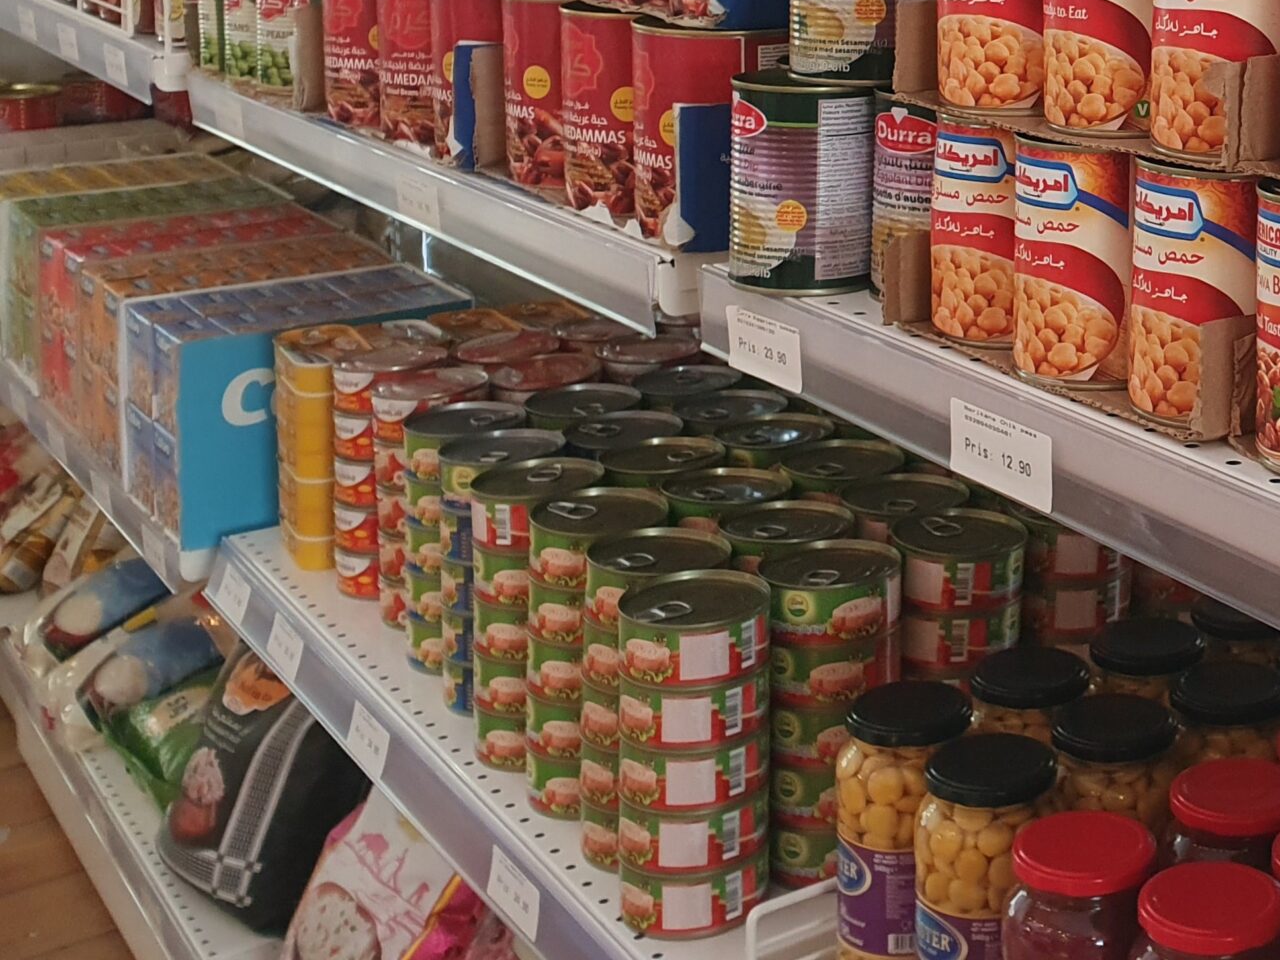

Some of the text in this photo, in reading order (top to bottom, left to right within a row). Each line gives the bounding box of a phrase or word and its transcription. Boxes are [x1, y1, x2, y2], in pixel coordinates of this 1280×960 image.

[1068, 5, 1089, 20] Eat
[877, 120, 932, 145] Durra
[966, 192, 1010, 207] حمص
[1036, 218, 1081, 235] حمص
[1157, 246, 1205, 265] حمص
[964, 436, 1033, 478] Pris: 12.90
